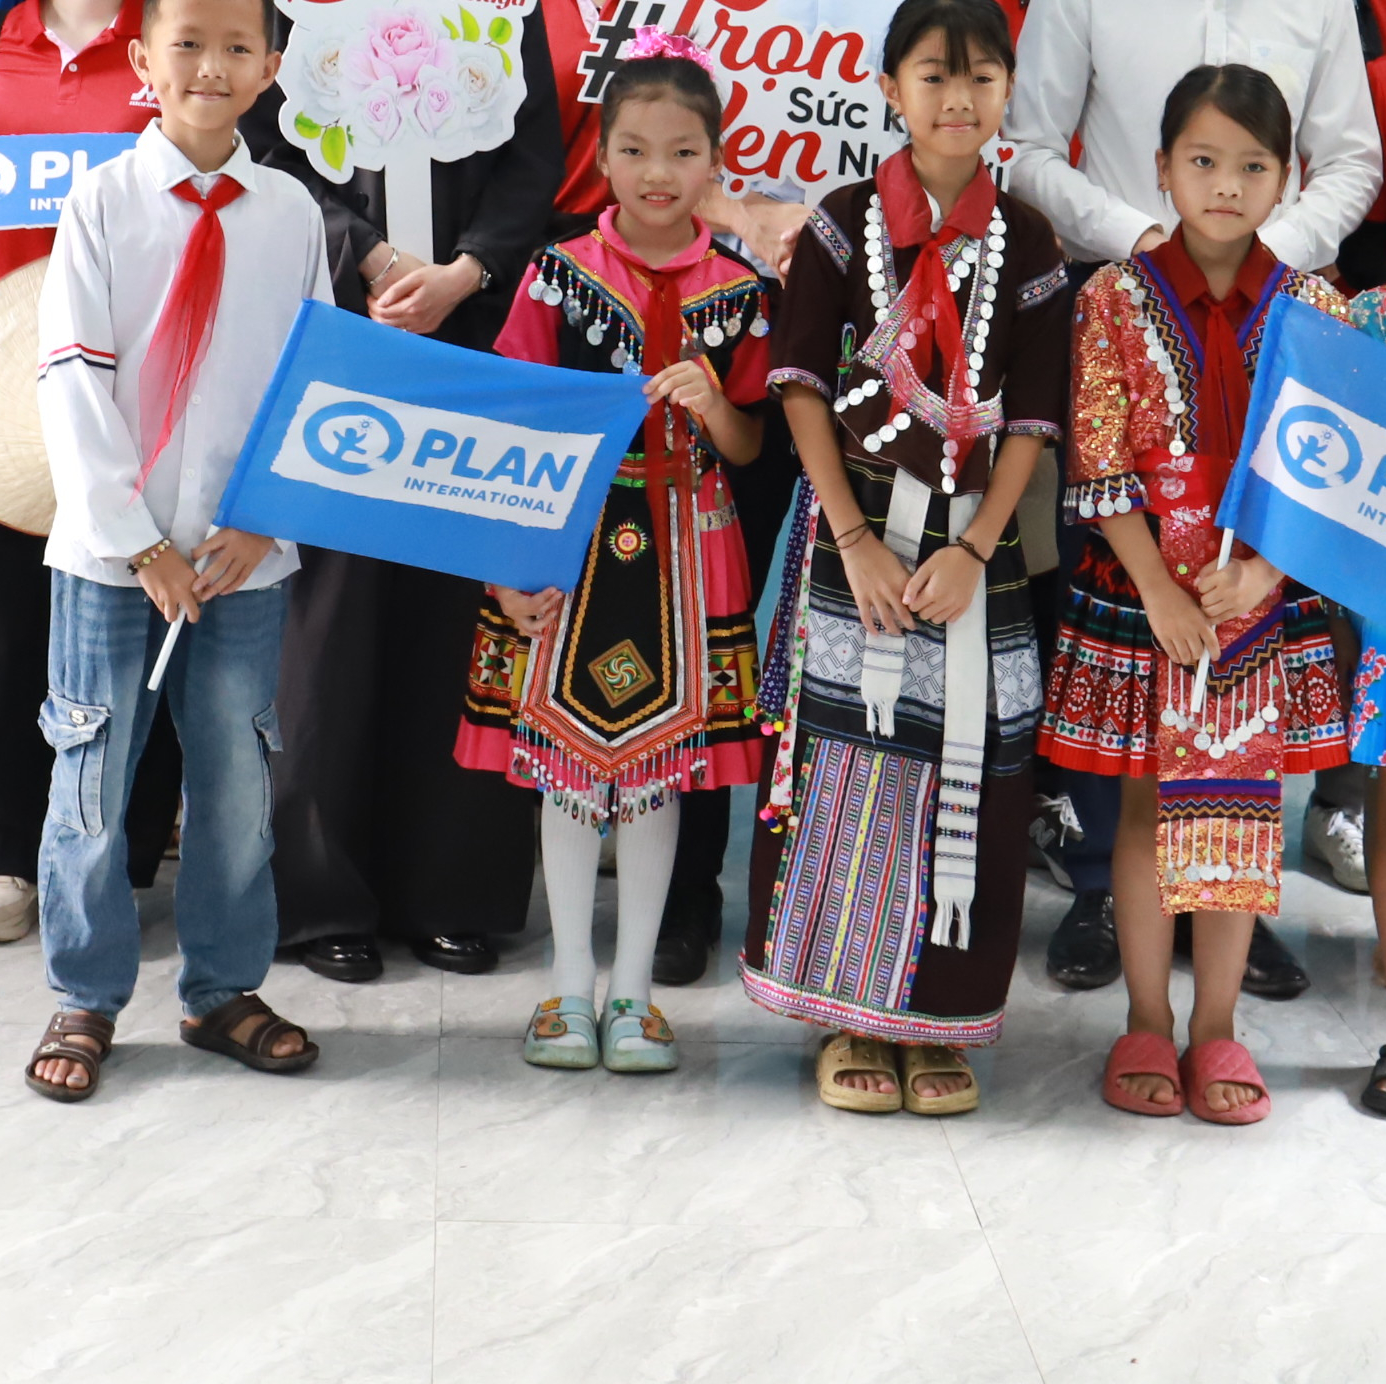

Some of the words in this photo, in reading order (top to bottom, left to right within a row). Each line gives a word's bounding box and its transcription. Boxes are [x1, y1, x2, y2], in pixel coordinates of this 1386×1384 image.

[787, 87, 869, 129] Sức
[412, 428, 579, 492] PLAN
[404, 476, 556, 515] INTERNATIONAL
